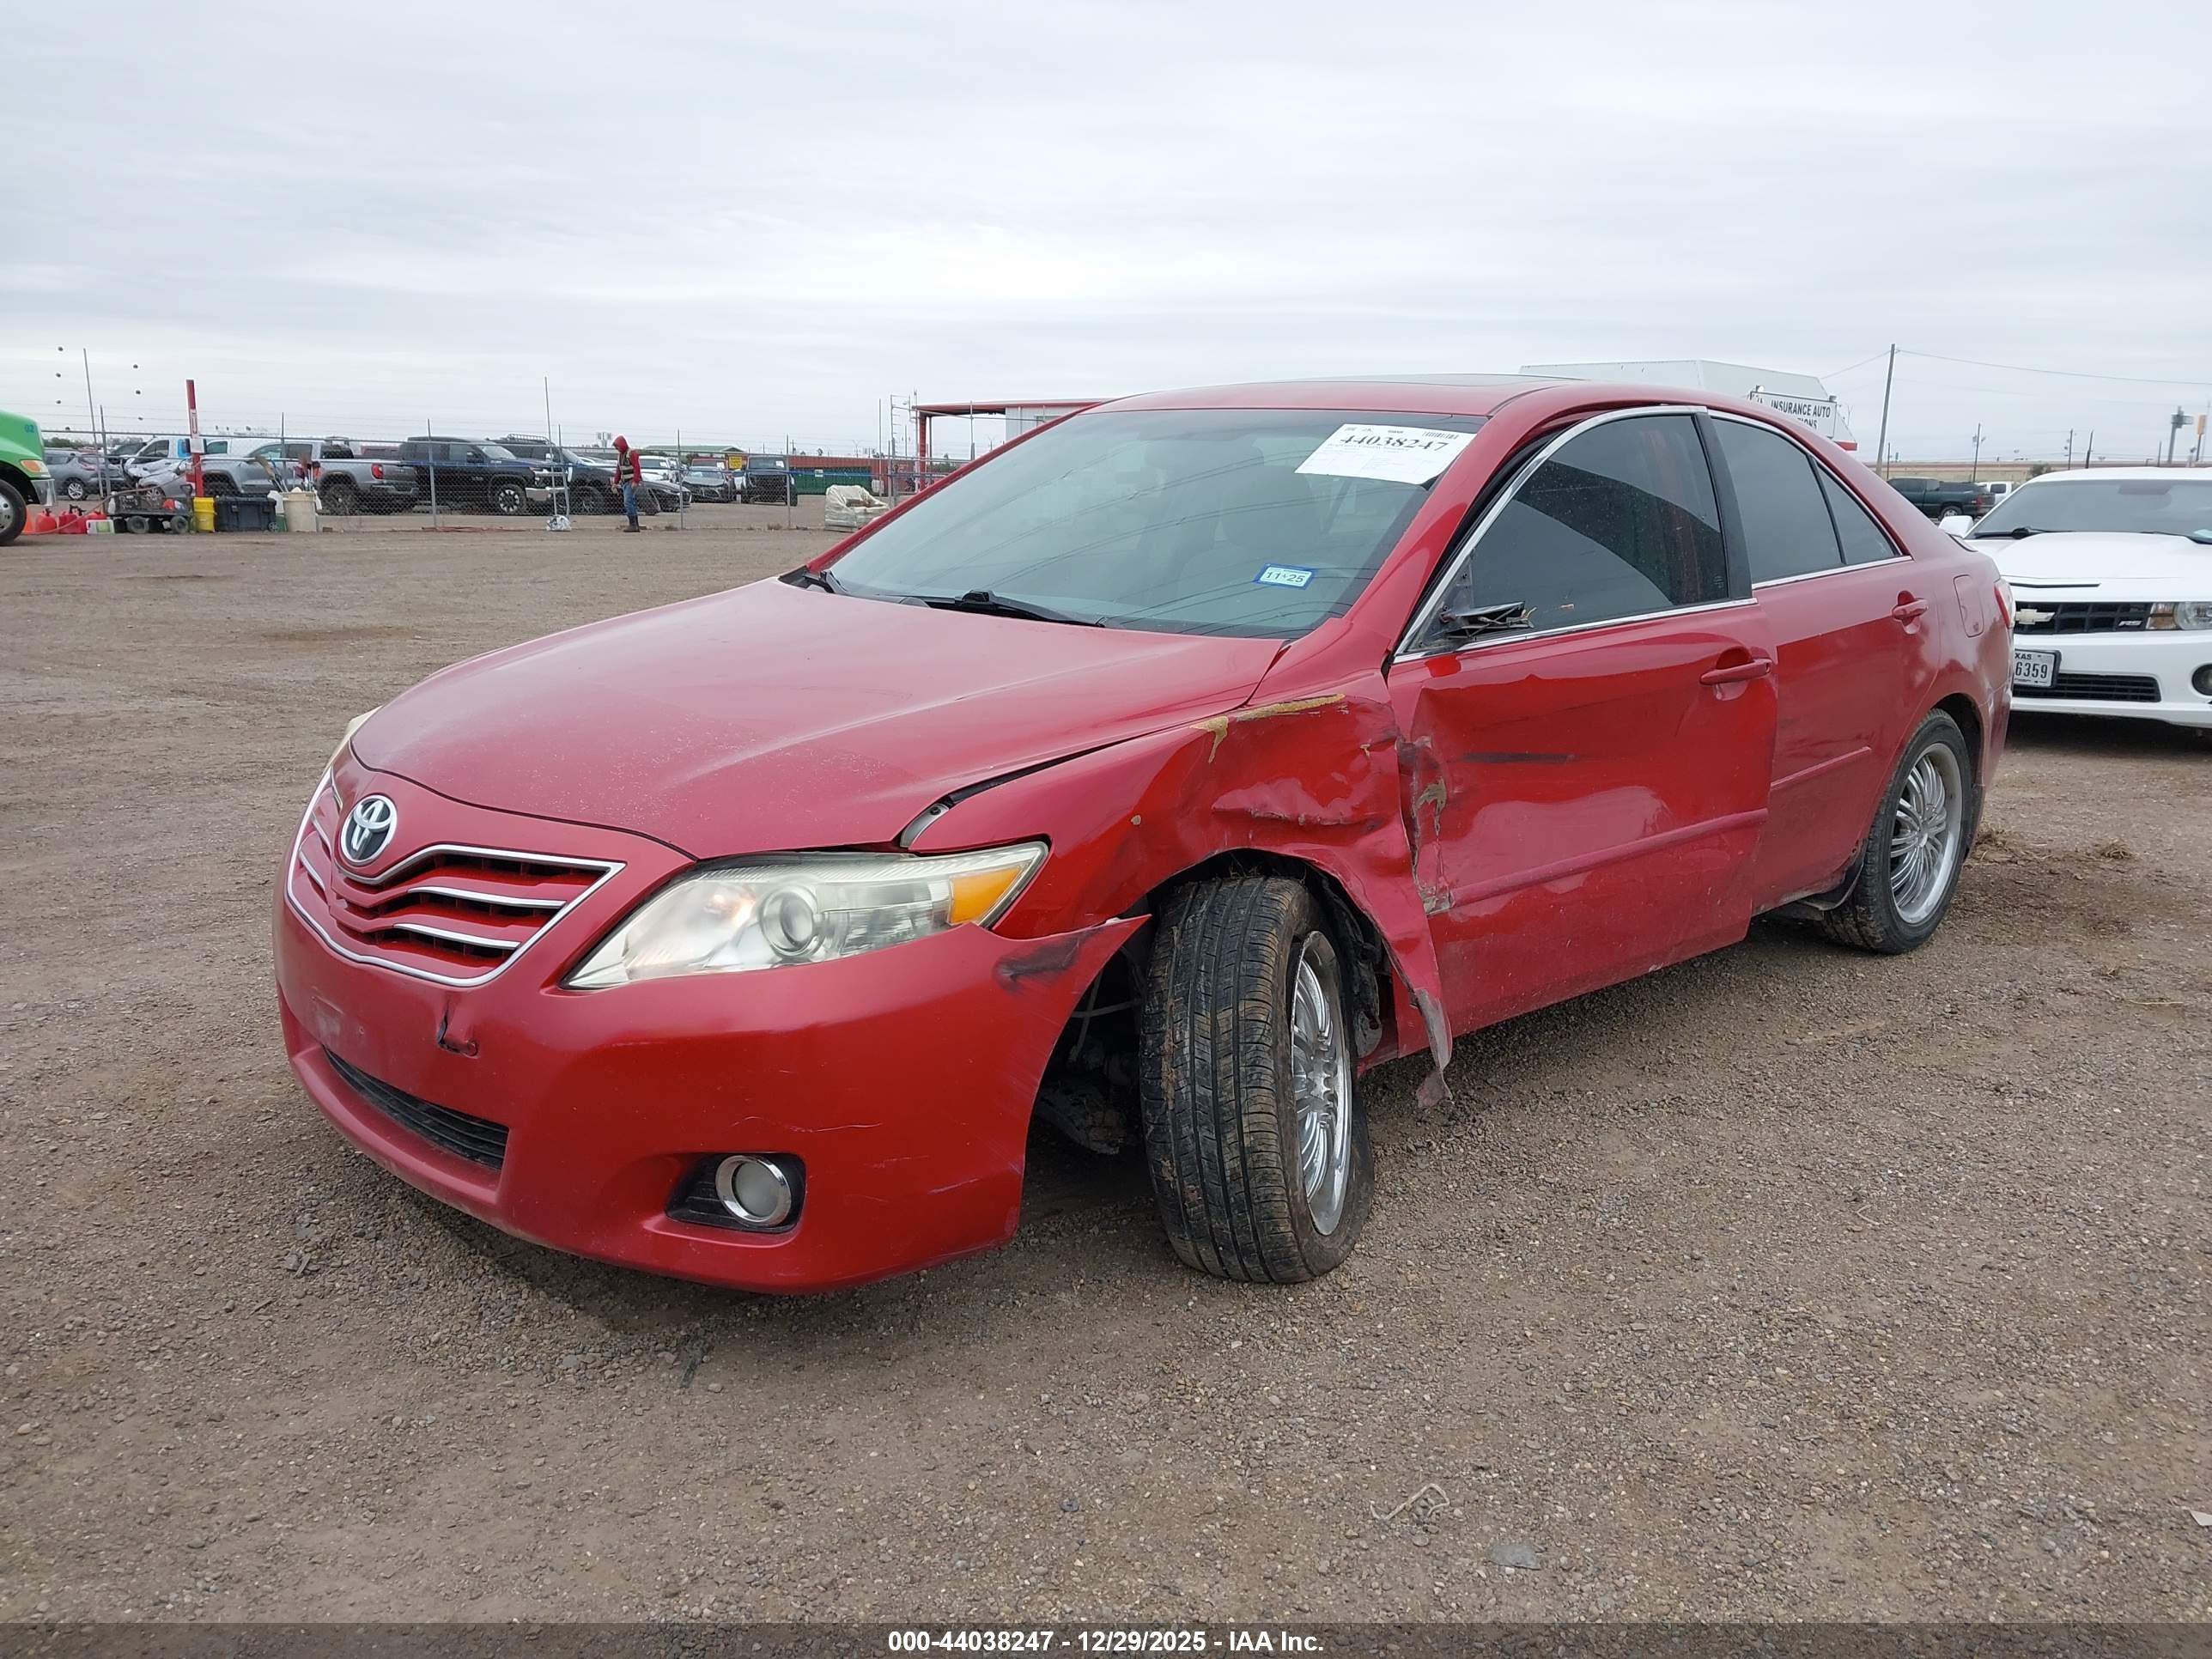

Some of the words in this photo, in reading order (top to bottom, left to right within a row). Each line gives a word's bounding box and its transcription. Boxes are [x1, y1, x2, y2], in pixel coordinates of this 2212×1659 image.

[1771, 398, 1812, 416] INSURANCE
[1813, 404, 1831, 418] AUTO
[1340, 434, 1449, 452] 44038247
[1286, 574, 1305, 583] 25
[2014, 661, 2048, 679] 6359
